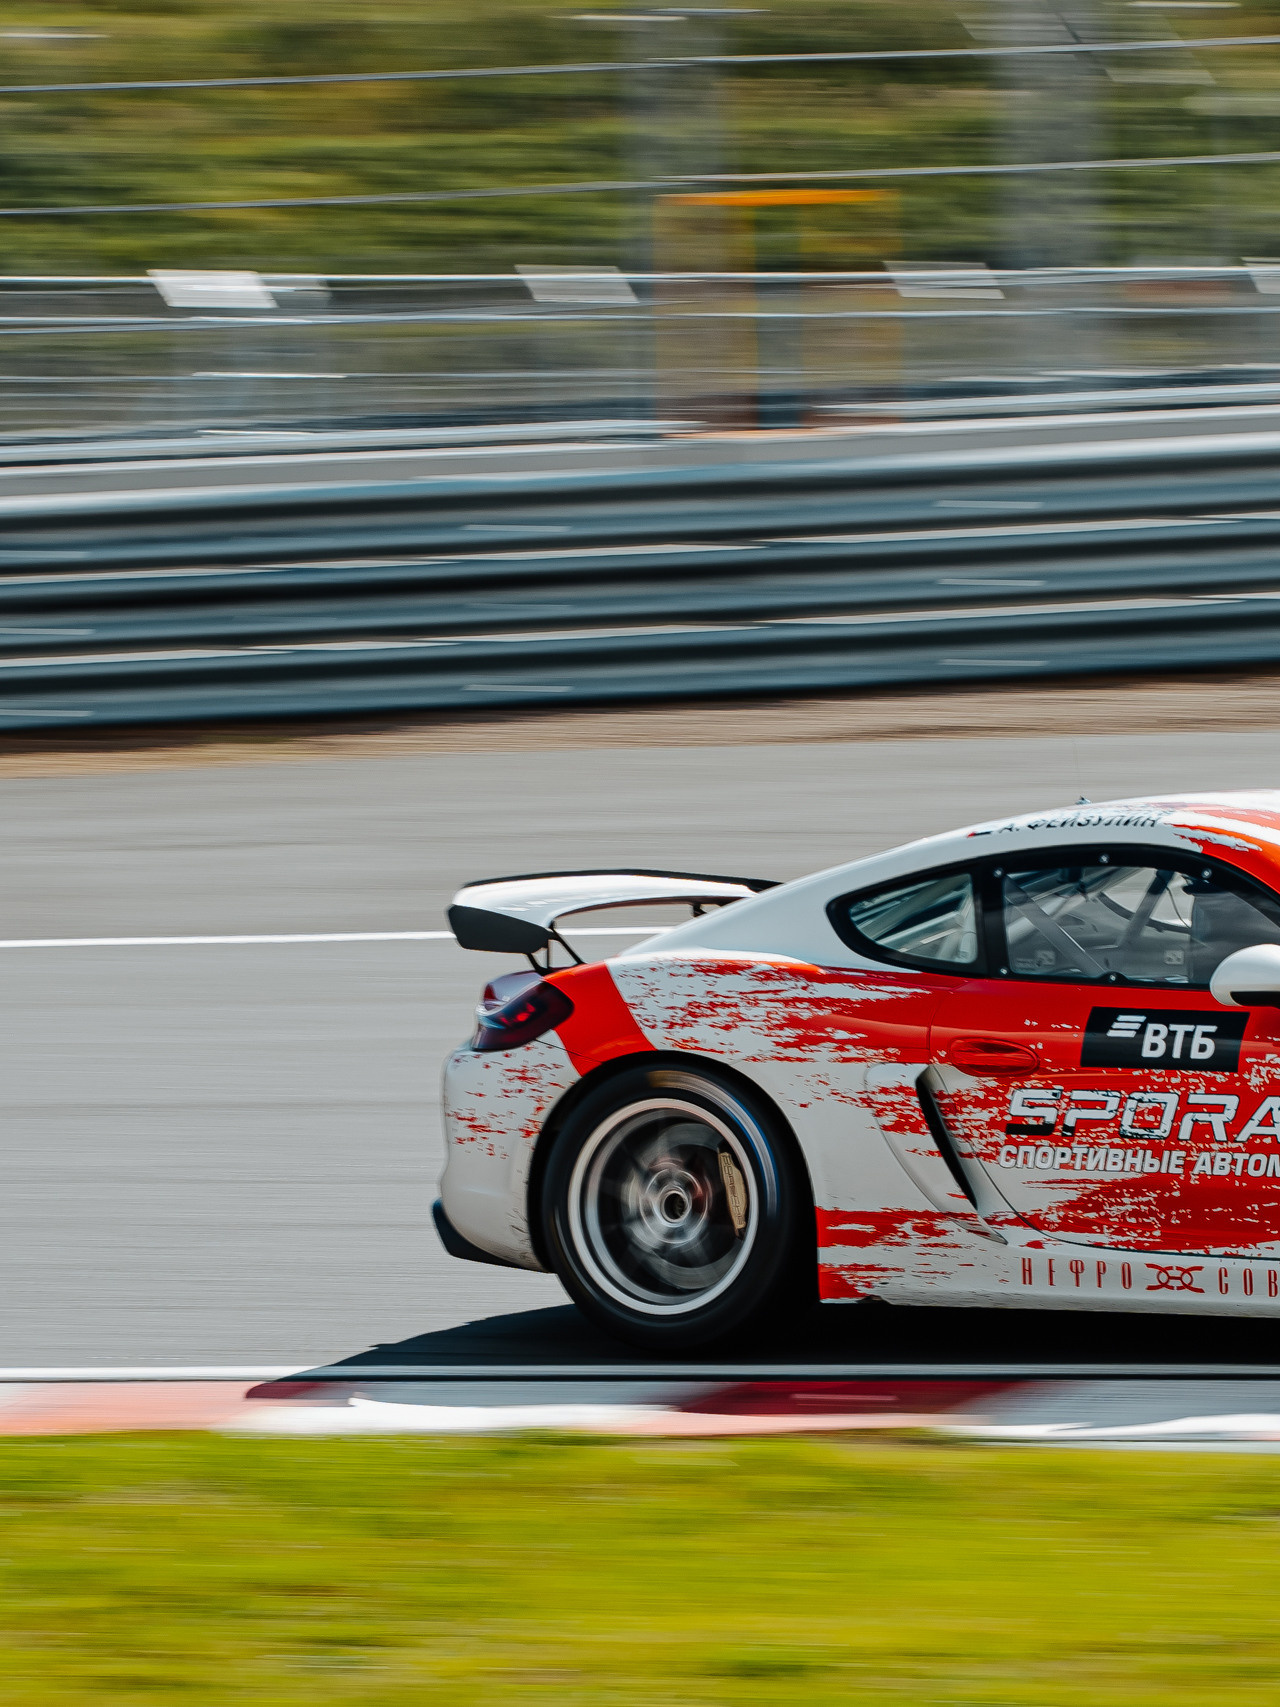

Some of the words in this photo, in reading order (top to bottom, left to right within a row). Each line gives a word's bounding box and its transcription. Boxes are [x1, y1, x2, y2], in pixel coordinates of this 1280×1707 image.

[1141, 1023, 1218, 1060] ВТБ
[1000, 1144, 1187, 1174] СПОРТИВНЫЕ
[1021, 1257, 1132, 1290] НЕФРО
